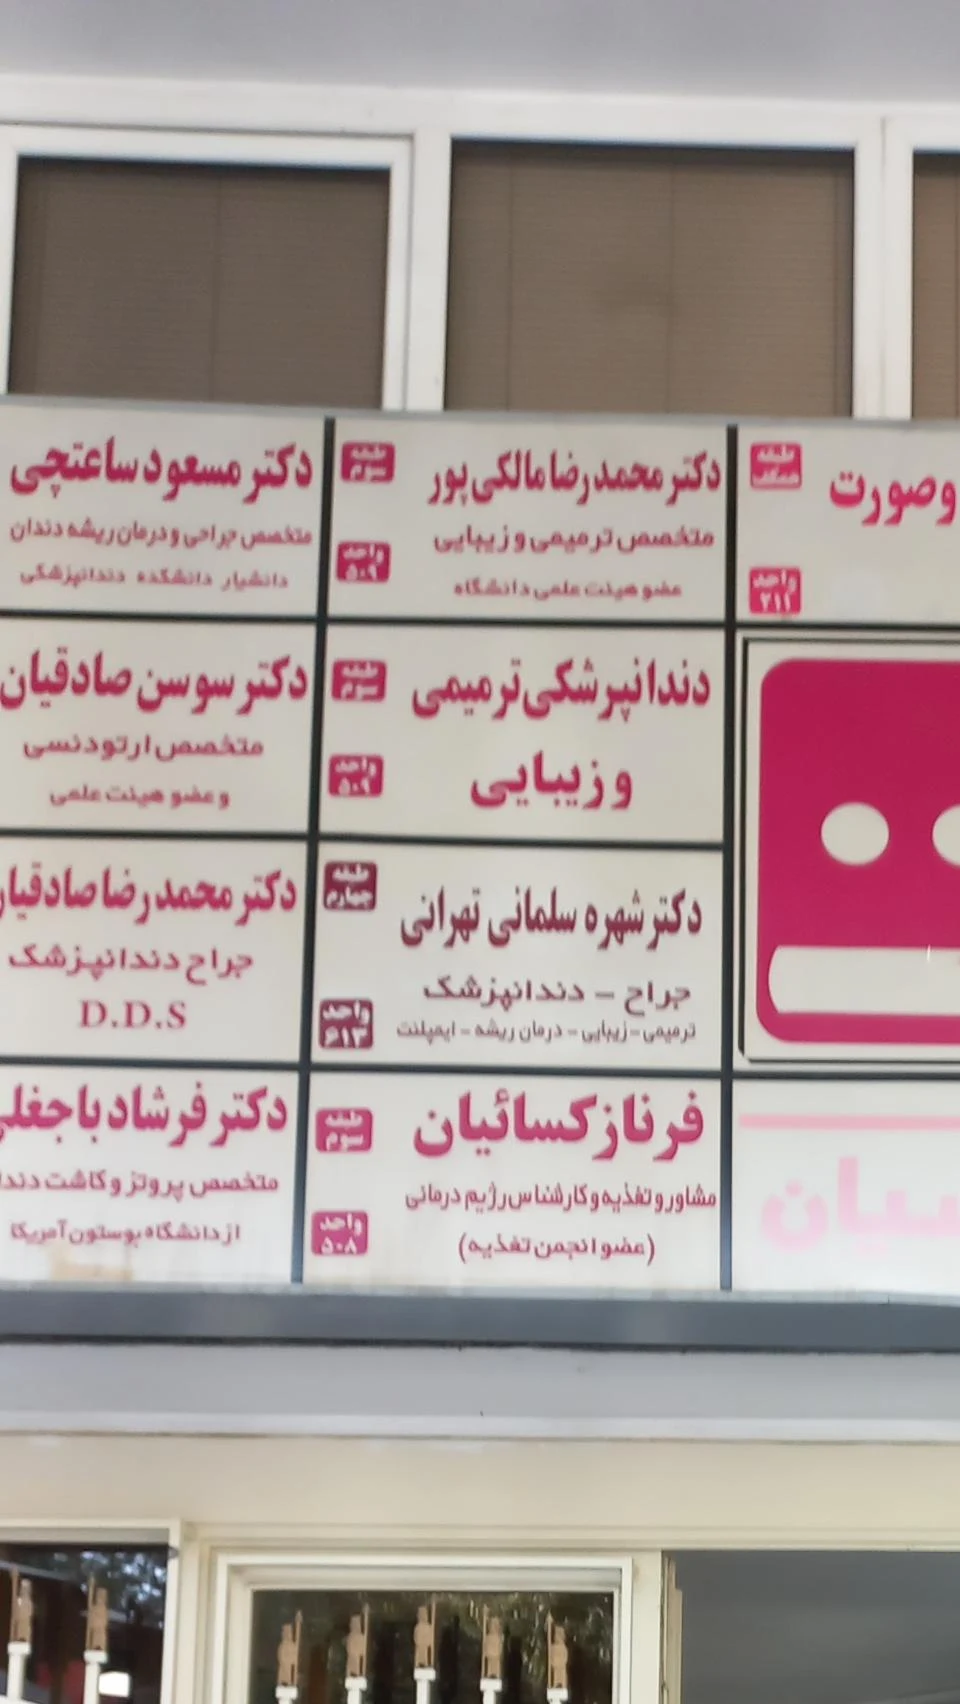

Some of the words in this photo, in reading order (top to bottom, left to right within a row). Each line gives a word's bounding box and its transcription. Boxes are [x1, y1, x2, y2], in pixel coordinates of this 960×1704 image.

[10, 436, 139, 498] ساعتچی
[143, 447, 242, 502] مسعود
[243, 442, 314, 505] دکتر
[665, 451, 721, 506] دکتر
[10, 517, 63, 542] دندان
[67, 516, 114, 545] ریشه
[183, 524, 237, 549] جراحی
[240, 525, 312, 550] متخصص
[434, 525, 510, 553] زیبایی
[530, 527, 613, 553] ترمیمی
[618, 527, 715, 554] متخصص
[20, 562, 126, 588] دندانپزشکی
[137, 566, 212, 587] دانشکده
[221, 568, 288, 592] دانشیار
[454, 578, 529, 598] دانشگاه
[534, 579, 580, 601] علمی
[642, 583, 682, 601] عضو
[0, 646, 133, 711] صادقیان
[136, 668, 236, 715] سوسن
[237, 654, 309, 716] دکتر
[412, 659, 520, 720] ترمیمی
[24, 734, 151, 760] ارتودنسی
[155, 735, 264, 761] متخصص
[50, 784, 100, 805] علمی
[470, 750, 605, 811] زیبایی
[613, 768, 633, 811] و
[171, 784, 214, 808] عضو
[0, 862, 98, 920] صادقیا
[235, 869, 298, 926] دکتر
[401, 886, 481, 949] تهرانی
[488, 886, 577, 948] سلمانی
[585, 889, 645, 950] شهره
[647, 889, 702, 951] دکتر
[8, 944, 181, 980] دندانپزشک
[186, 946, 254, 985] جراح
[423, 974, 585, 1012] دندانپزشک
[624, 981, 691, 1016] جراح
[80, 1000, 187, 1029] D.D.S
[475, 1018, 515, 1041] ریشه
[519, 1020, 562, 1043] درمان
[643, 1020, 696, 1043] ترمیمی
[107, 1081, 208, 1148] فرشاد
[210, 1086, 288, 1148] دکتر
[413, 1088, 598, 1159] کسائیان
[592, 1090, 704, 1163] فرناز
[326, 1132, 363, 1151] سوم
[45, 1168, 107, 1191] کاشت
[125, 1171, 184, 1202] پروتز
[190, 1176, 278, 1198] متخصص
[404, 1184, 461, 1210] درمانی
[664, 1184, 716, 1213] مشاور
[10, 1219, 66, 1246] آمریکا
[69, 1223, 142, 1248] بوستون
[145, 1221, 220, 1241] دانشگاه
[222, 1223, 240, 1245] از
[534, 1237, 596, 1260] انجمن
